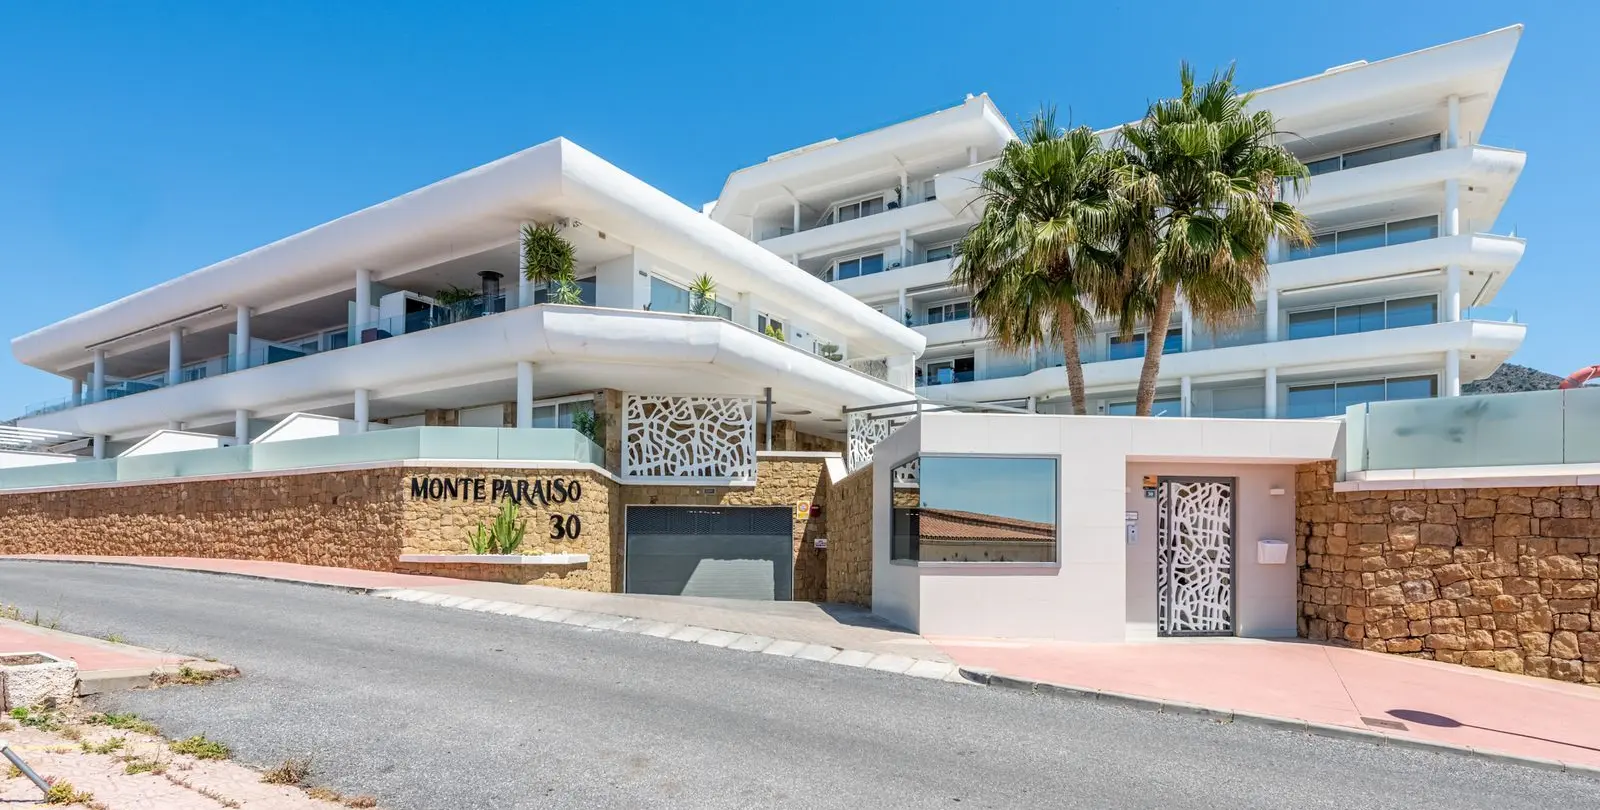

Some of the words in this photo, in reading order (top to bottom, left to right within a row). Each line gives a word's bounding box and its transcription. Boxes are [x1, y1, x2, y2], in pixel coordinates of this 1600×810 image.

[411, 477, 486, 500] MONTE
[492, 478, 582, 506] PARAISO
[550, 514, 581, 539] 30
